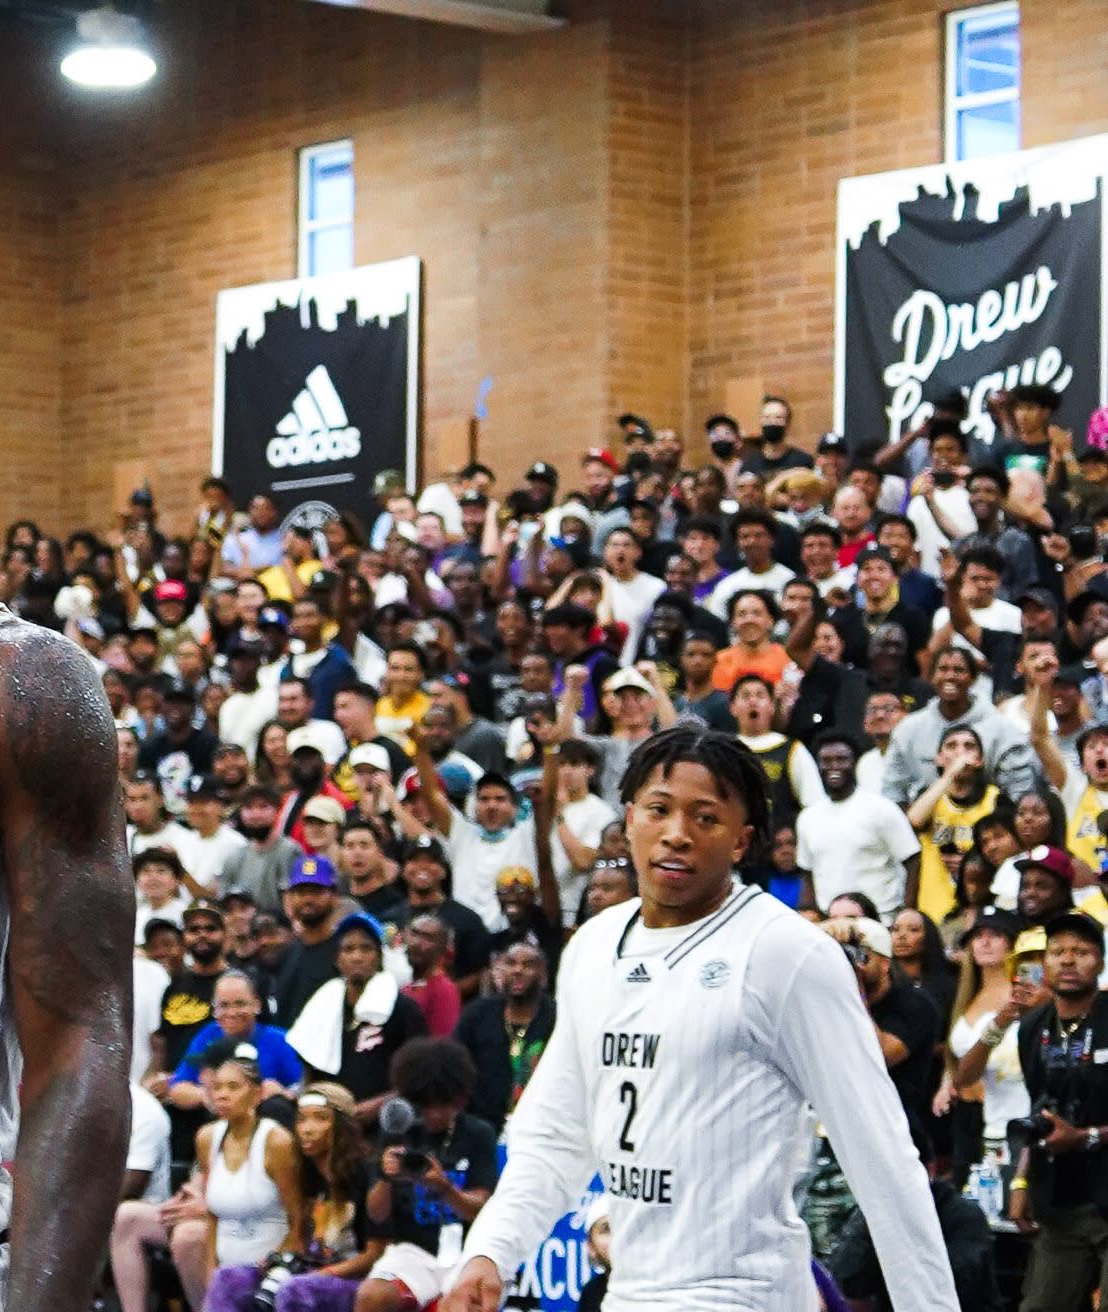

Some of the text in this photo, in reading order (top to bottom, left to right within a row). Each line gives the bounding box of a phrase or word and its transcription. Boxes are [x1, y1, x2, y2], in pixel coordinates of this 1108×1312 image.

[884, 265, 1058, 388] Drew
[266, 427, 362, 468] adidas
[601, 1032, 661, 1069] DREW
[619, 1081, 639, 1152] 2
[608, 1162, 672, 1205] EAGUE
